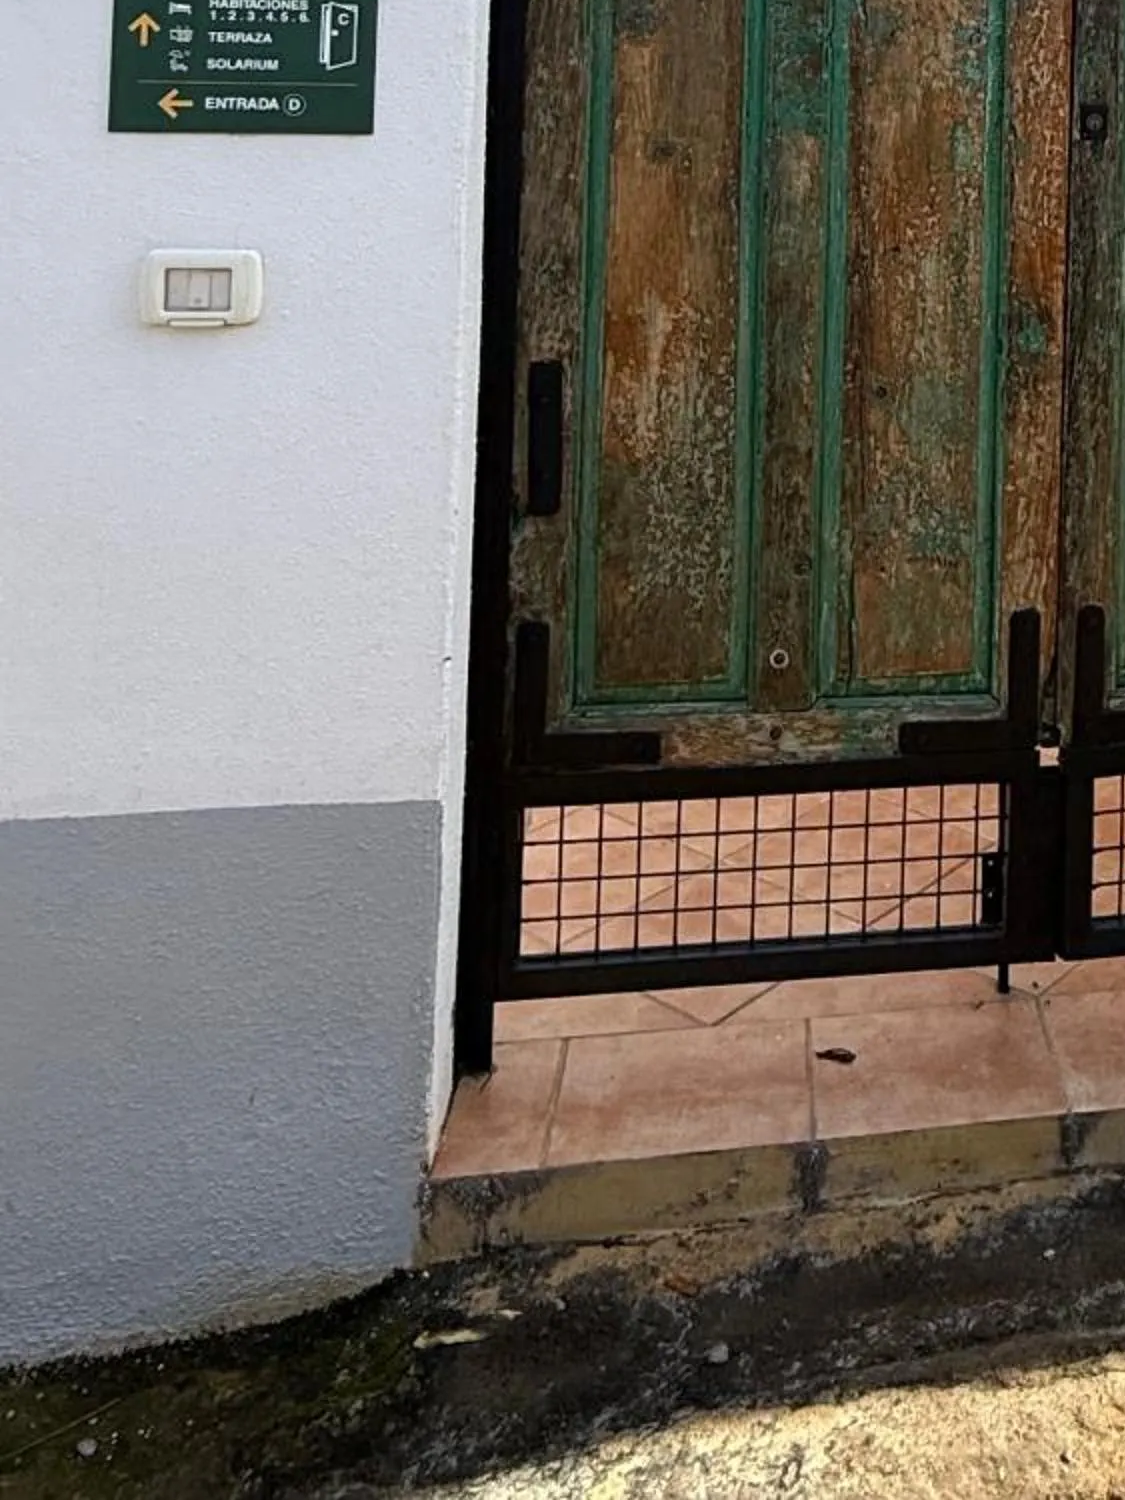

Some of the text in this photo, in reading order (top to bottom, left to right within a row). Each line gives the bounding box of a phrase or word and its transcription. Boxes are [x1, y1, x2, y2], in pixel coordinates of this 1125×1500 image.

[337, 13, 350, 26] C
[208, 31, 273, 44] TERRAZA
[206, 57, 280, 71] SOLARIUM
[204, 97, 280, 111] ENTRADA
